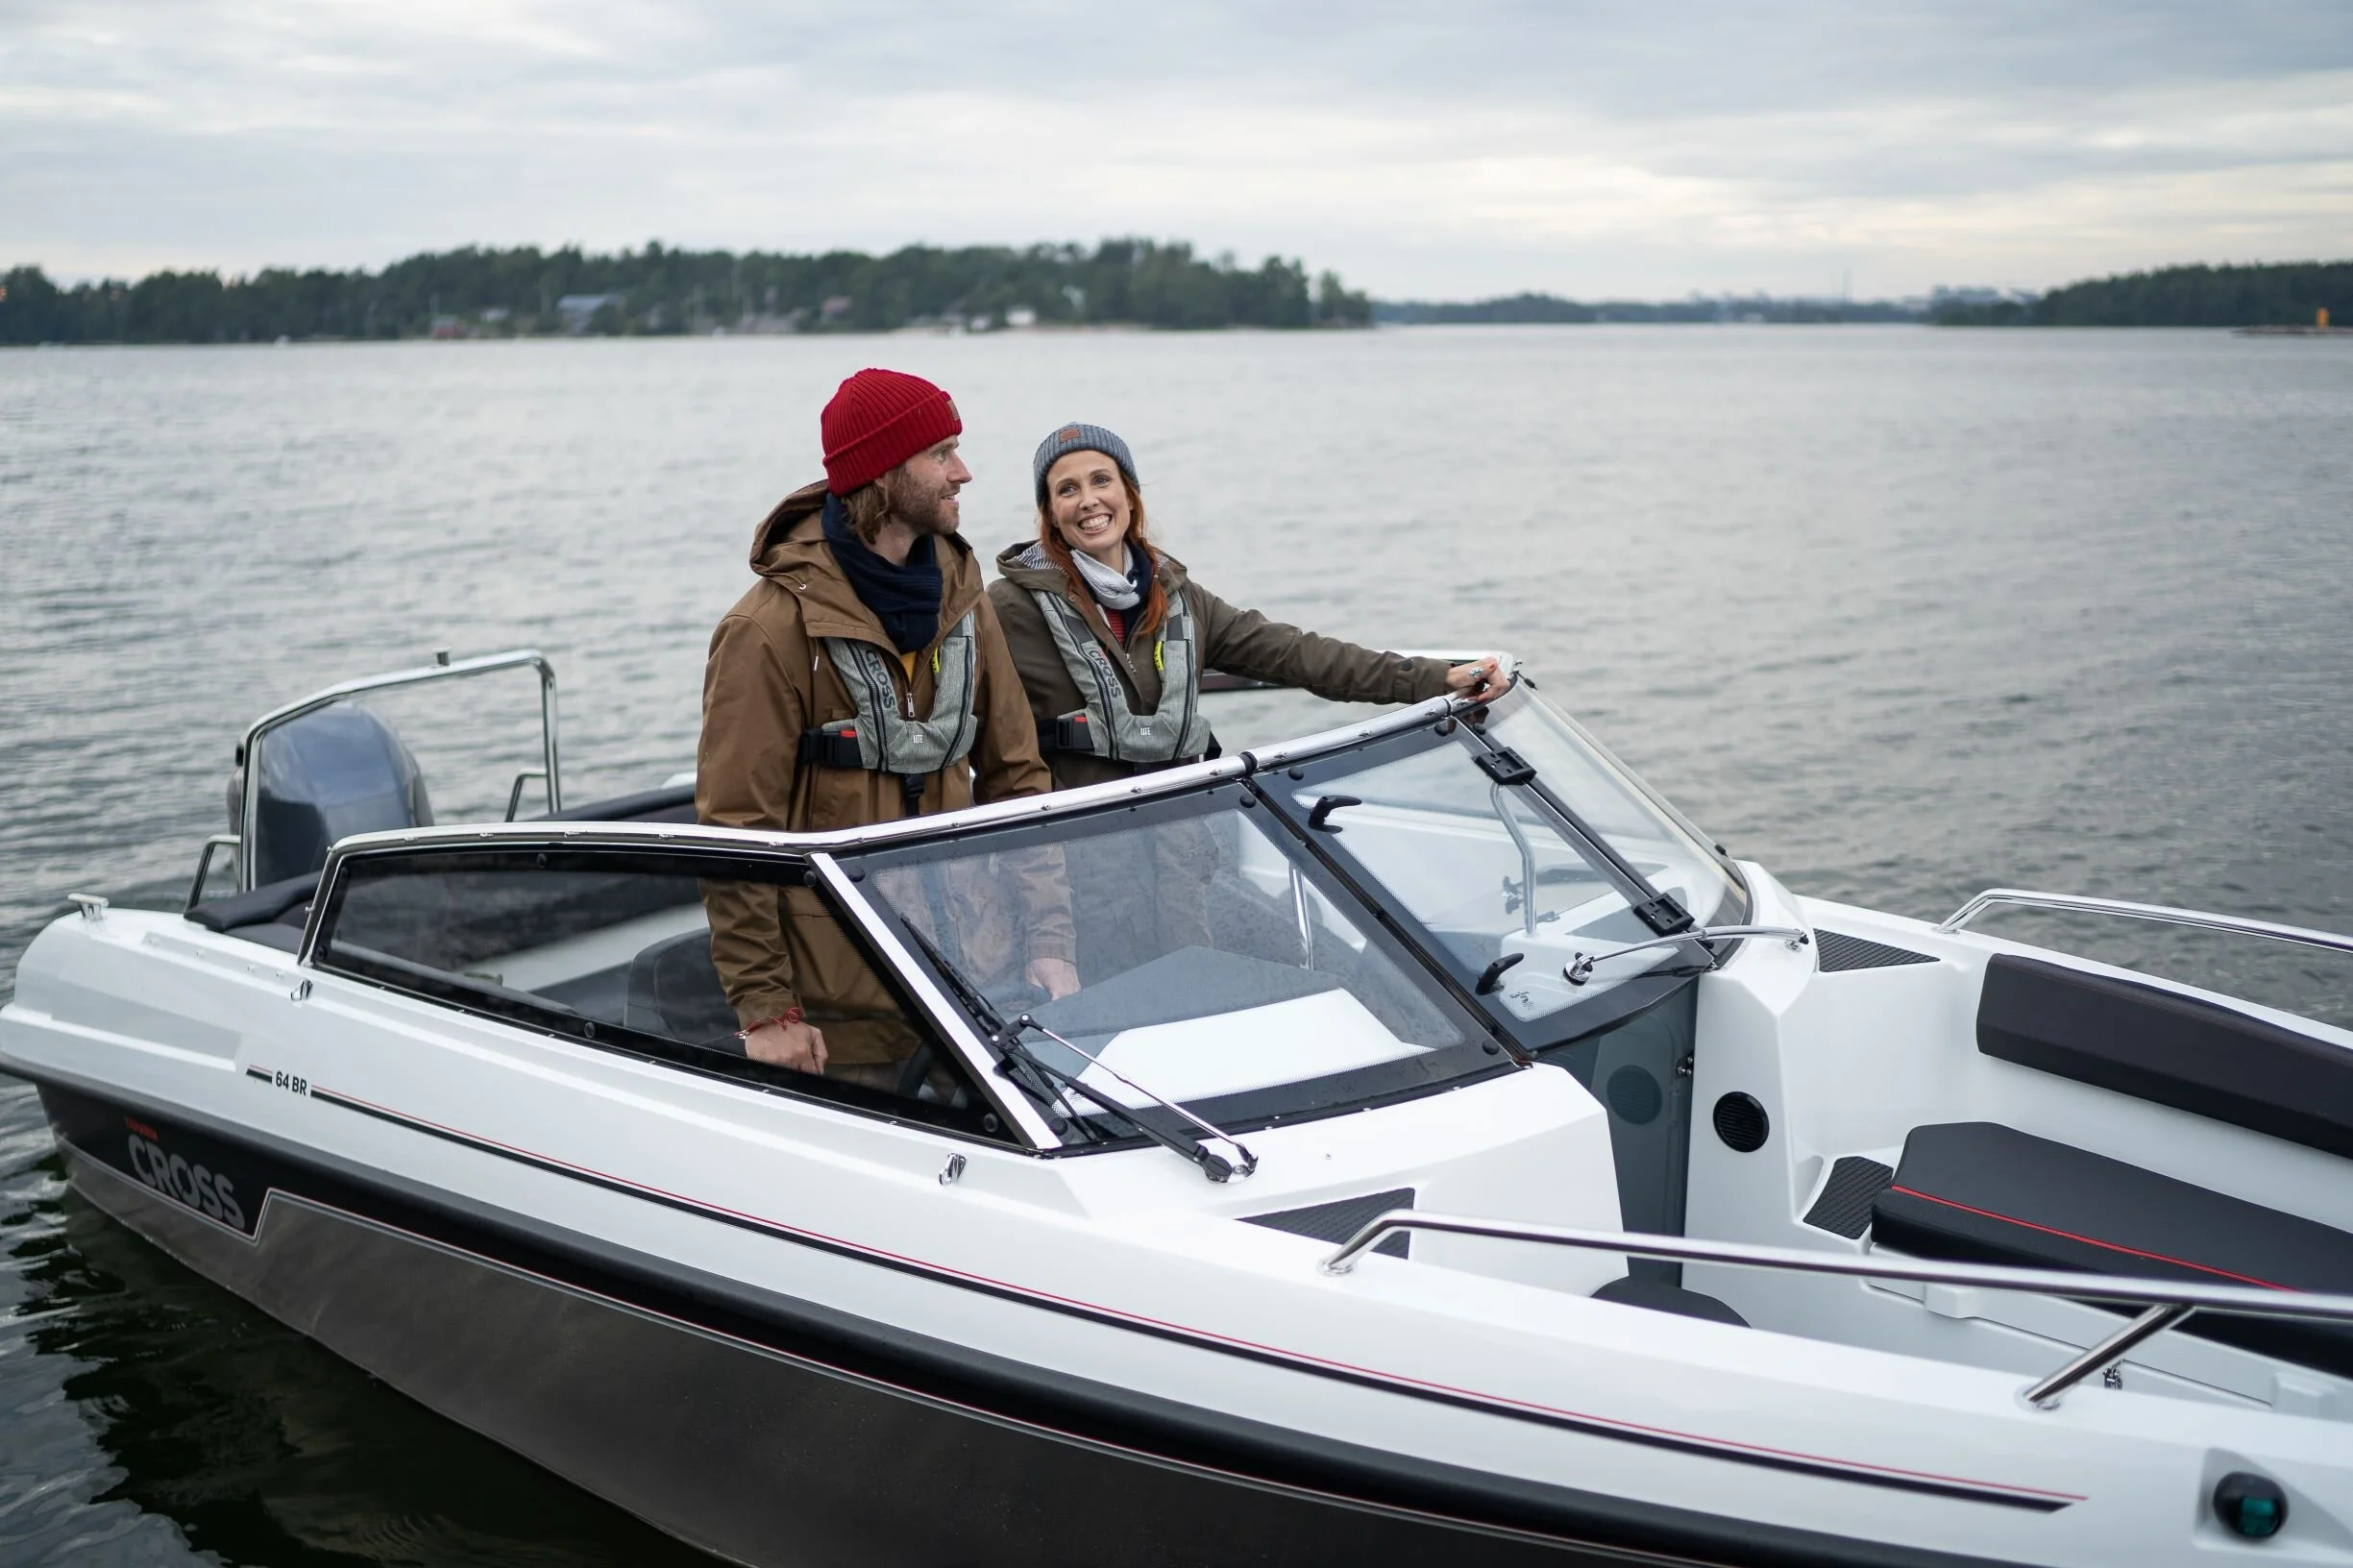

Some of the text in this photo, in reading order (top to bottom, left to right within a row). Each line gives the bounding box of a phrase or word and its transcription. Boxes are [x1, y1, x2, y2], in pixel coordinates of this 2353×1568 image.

[867, 649, 895, 709] CROSS
[1089, 649, 1121, 698] CROSS
[913, 734, 923, 744] LITE
[276, 1070, 307, 1096] 64 BR
[128, 1134, 246, 1230] CROSS
